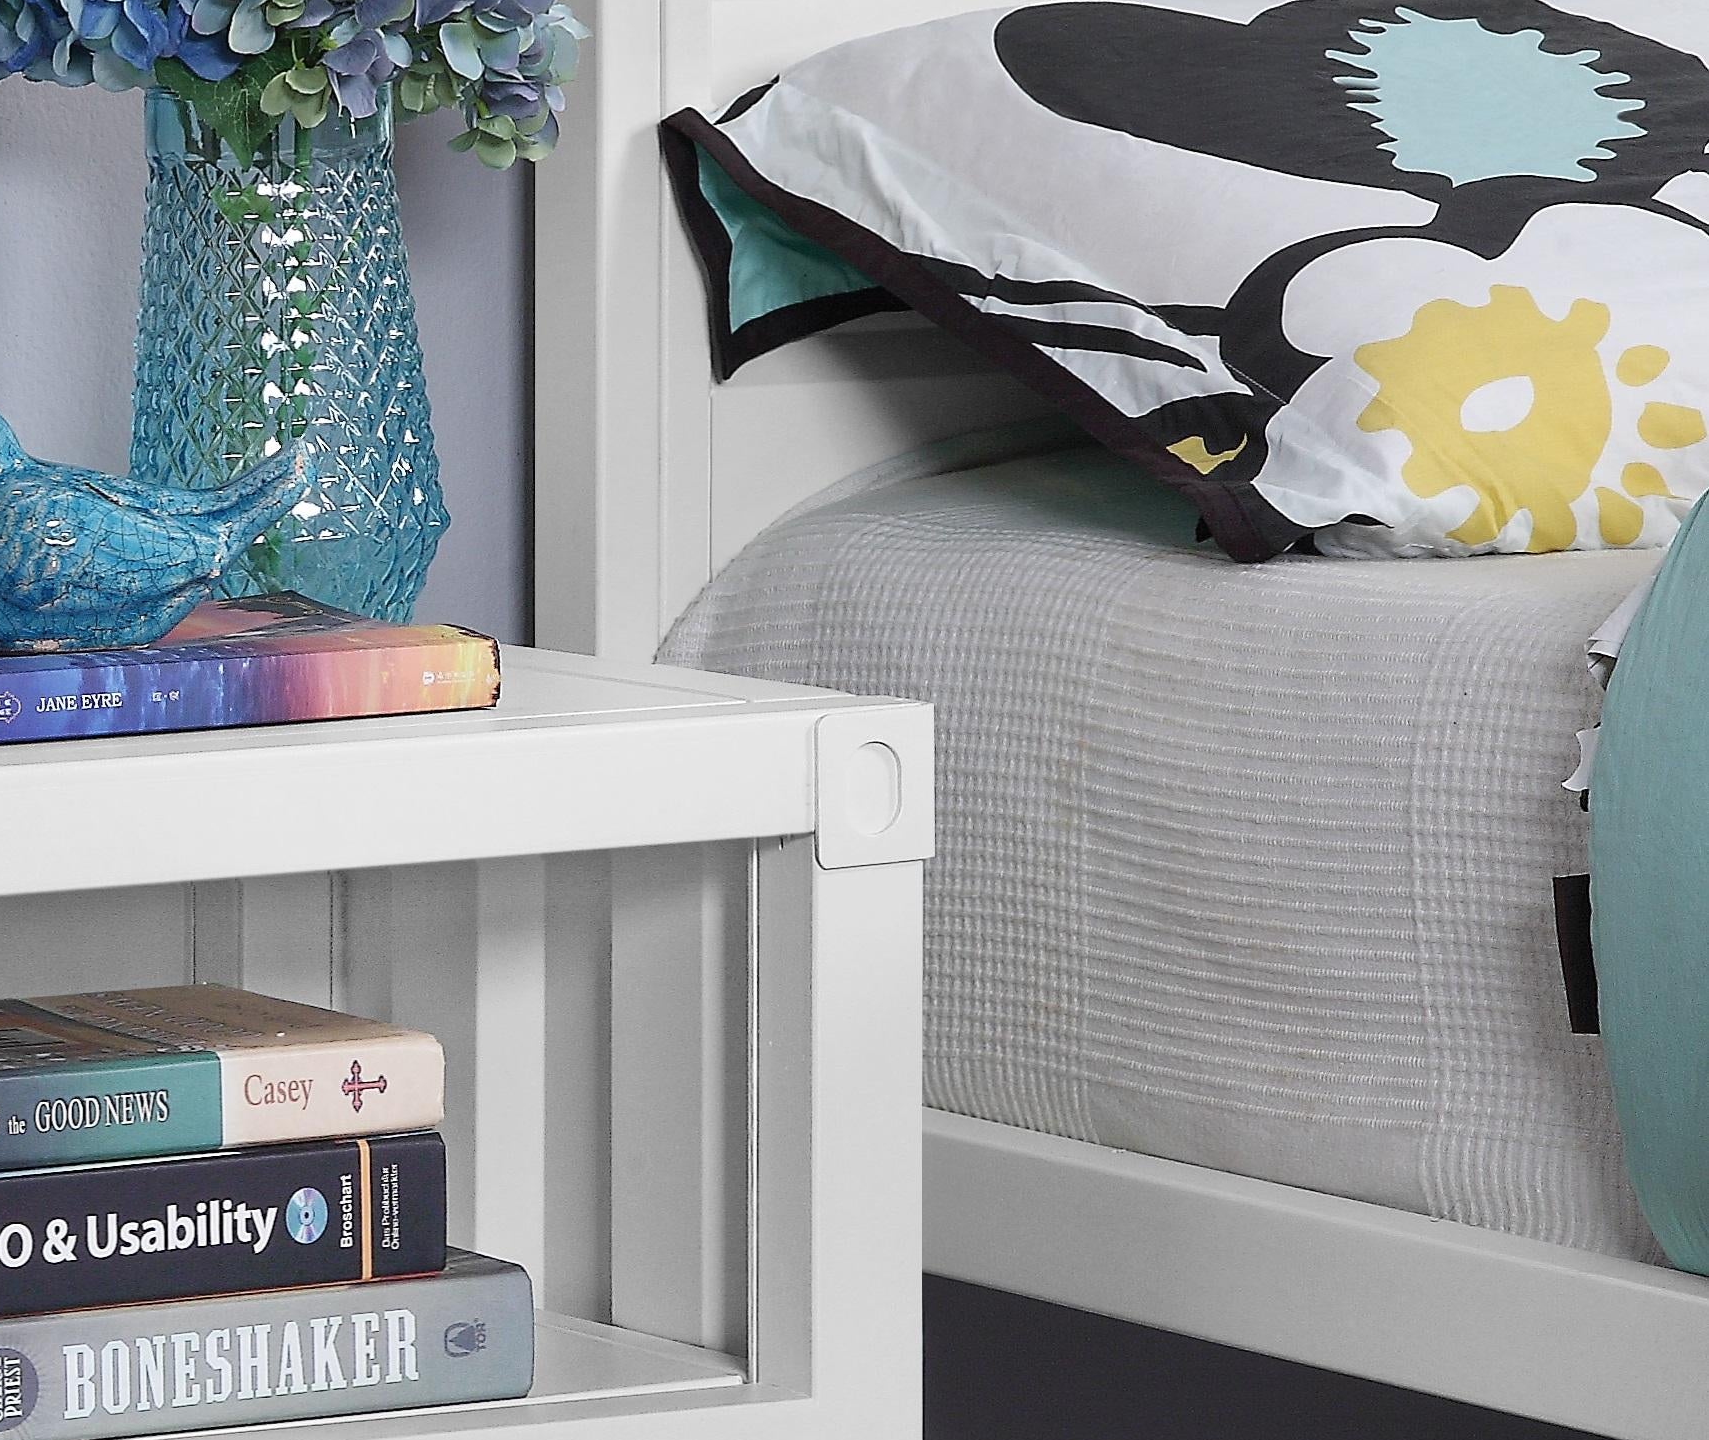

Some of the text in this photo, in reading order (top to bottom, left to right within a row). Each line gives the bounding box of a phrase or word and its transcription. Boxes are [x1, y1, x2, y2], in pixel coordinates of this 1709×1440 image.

[35, 691, 123, 713] JANE EYRE
[7, 1115, 26, 1136] the
[34, 1097, 100, 1133] GOOD
[104, 1090, 169, 1127] NEWS
[243, 1073, 314, 1110] Casey
[42, 1218, 78, 1264] &
[86, 1199, 279, 1255] Usability
[339, 1173, 354, 1249] Broschart
[3, 1357, 23, 1418] PRIEST
[62, 1309, 420, 1420] BONESHAKER
